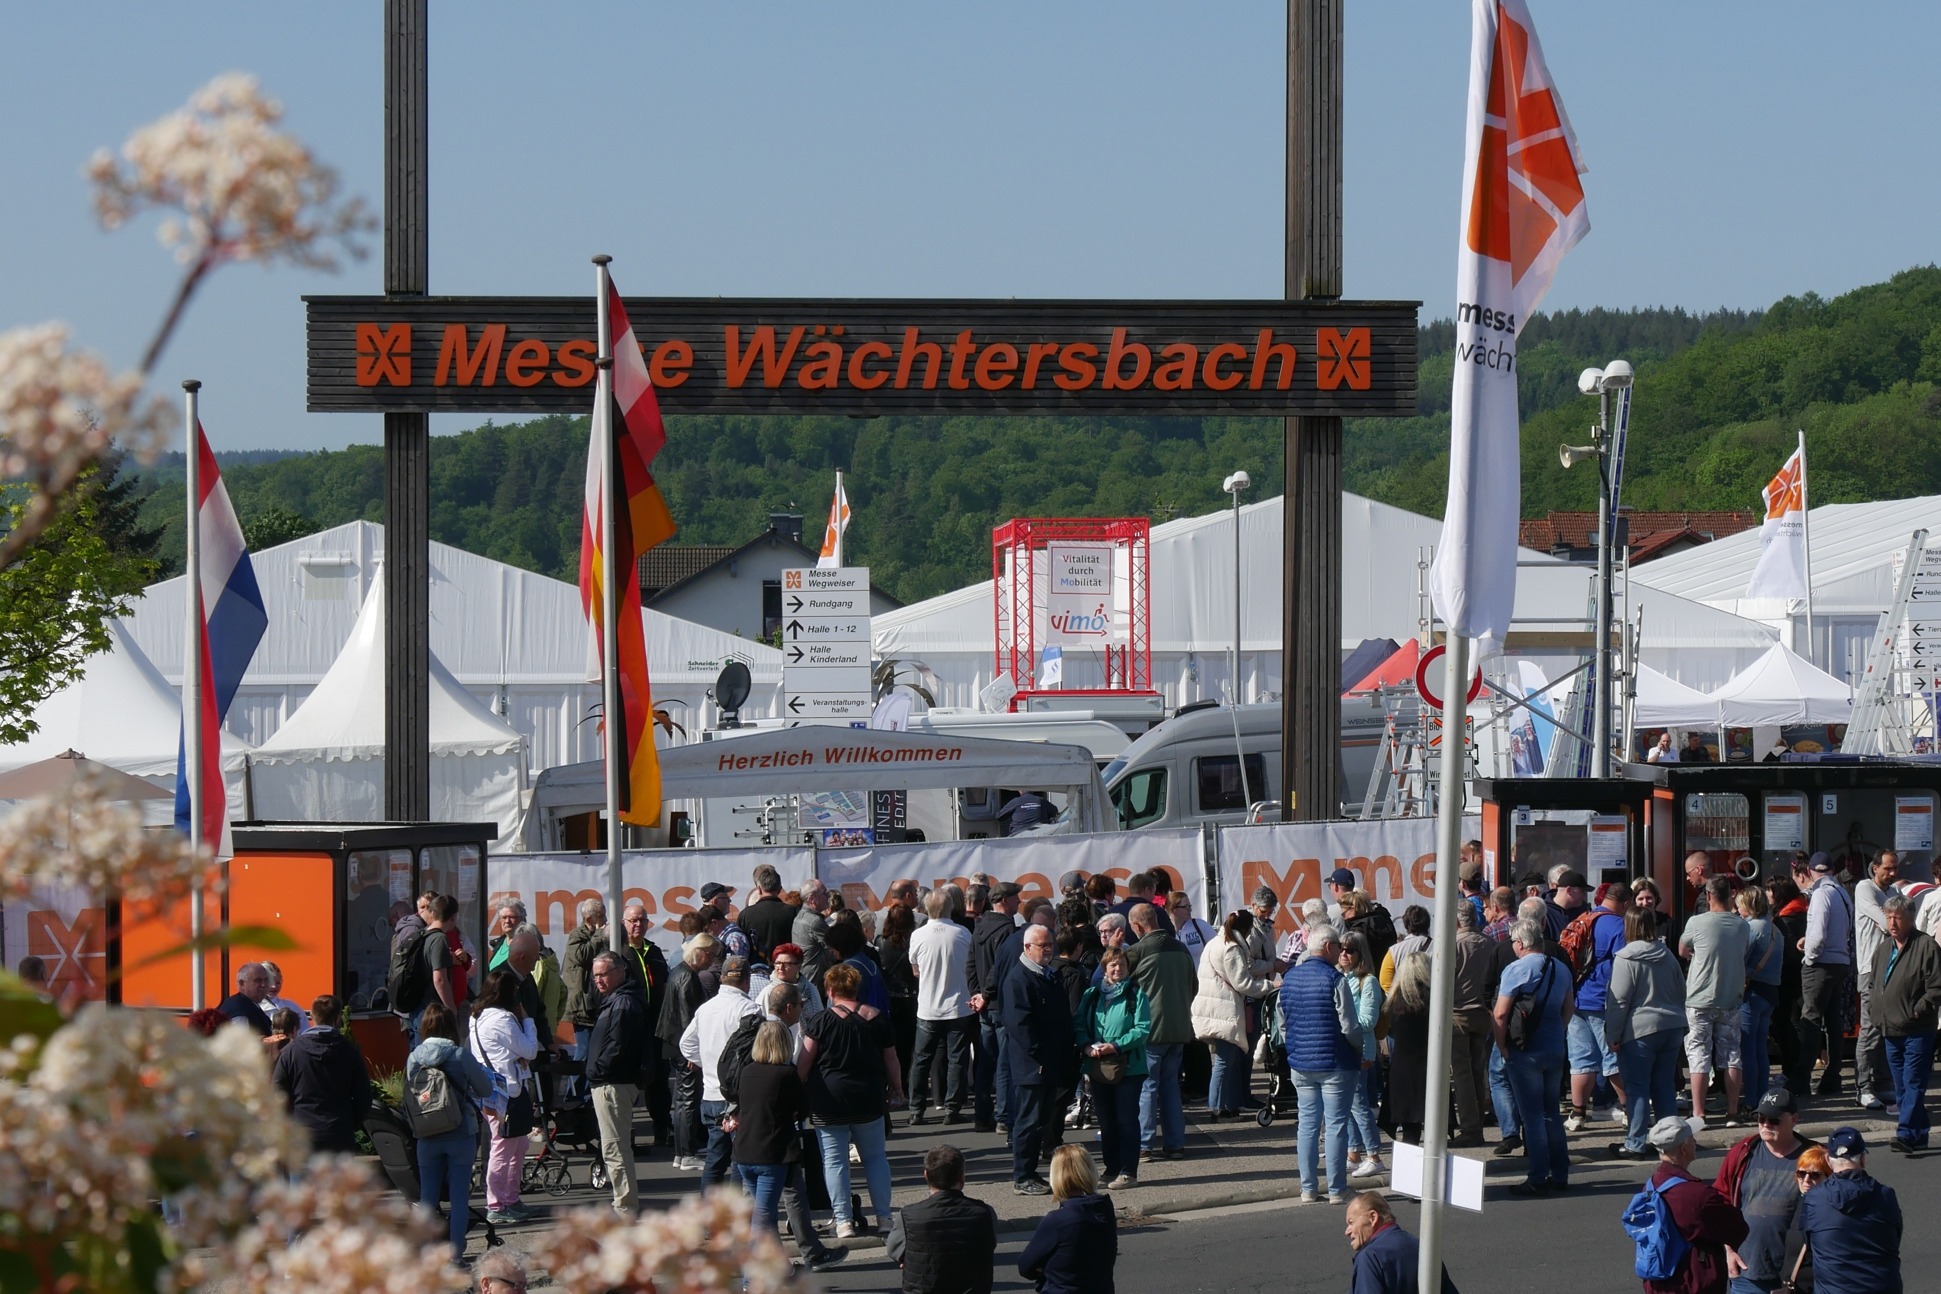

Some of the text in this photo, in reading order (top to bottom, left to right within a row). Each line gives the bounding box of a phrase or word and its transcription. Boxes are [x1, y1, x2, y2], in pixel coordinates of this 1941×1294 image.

[434, 324, 1297, 391] Mese Wächtersbach
[1457, 336, 1516, 372] wäch
[1062, 554, 1100, 564] Vitalität
[808, 569, 837, 578] Messe
[1068, 566, 1094, 575] durch
[808, 579, 856, 589] Wegweiser
[1060, 577, 1102, 587] Mobilität
[809, 599, 853, 609] Rundgang
[807, 625, 830, 634] Halle
[833, 625, 838, 633] 1
[846, 625, 857, 633] 12
[809, 646, 832, 654] Halle
[809, 655, 858, 663] Kinderland
[812, 699, 868, 708] Veranstaltungs-
[717, 746, 962, 771] Herzlich Willkommen
[1691, 799, 1699, 810] 4
[1826, 799, 1834, 811] 5
[875, 787, 891, 843] FINES
[1520, 813, 1527, 821] 3
